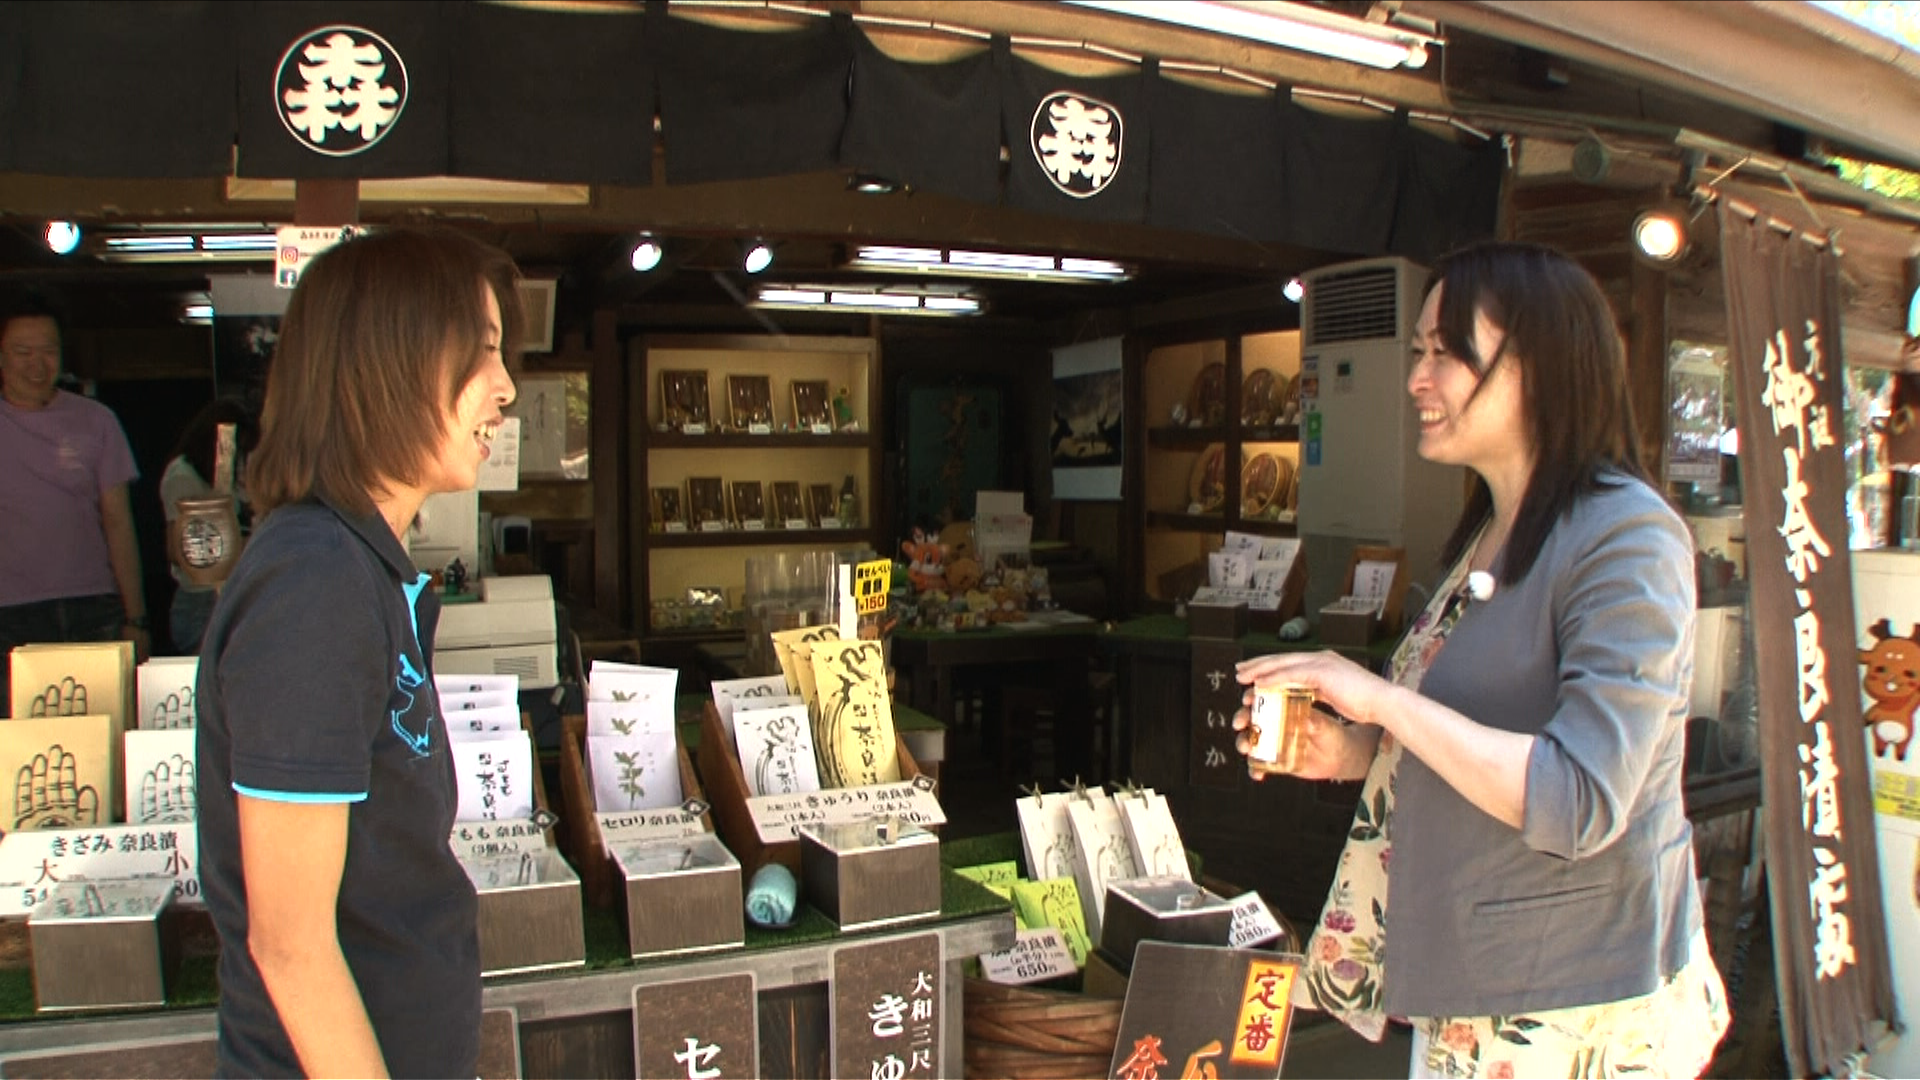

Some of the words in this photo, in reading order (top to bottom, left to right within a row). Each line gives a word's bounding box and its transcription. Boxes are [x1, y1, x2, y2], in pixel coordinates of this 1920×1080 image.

[284, 32, 399, 144] 森
[1038, 97, 1117, 188] 森
[1204, 670, 1228, 768] すいか
[34, 858, 60, 886] 大
[164, 850, 190, 877] 小
[910, 971, 933, 1073] 大和三尺
[1238, 967, 1287, 1054] 定番
[673, 1038, 722, 1080] セ
